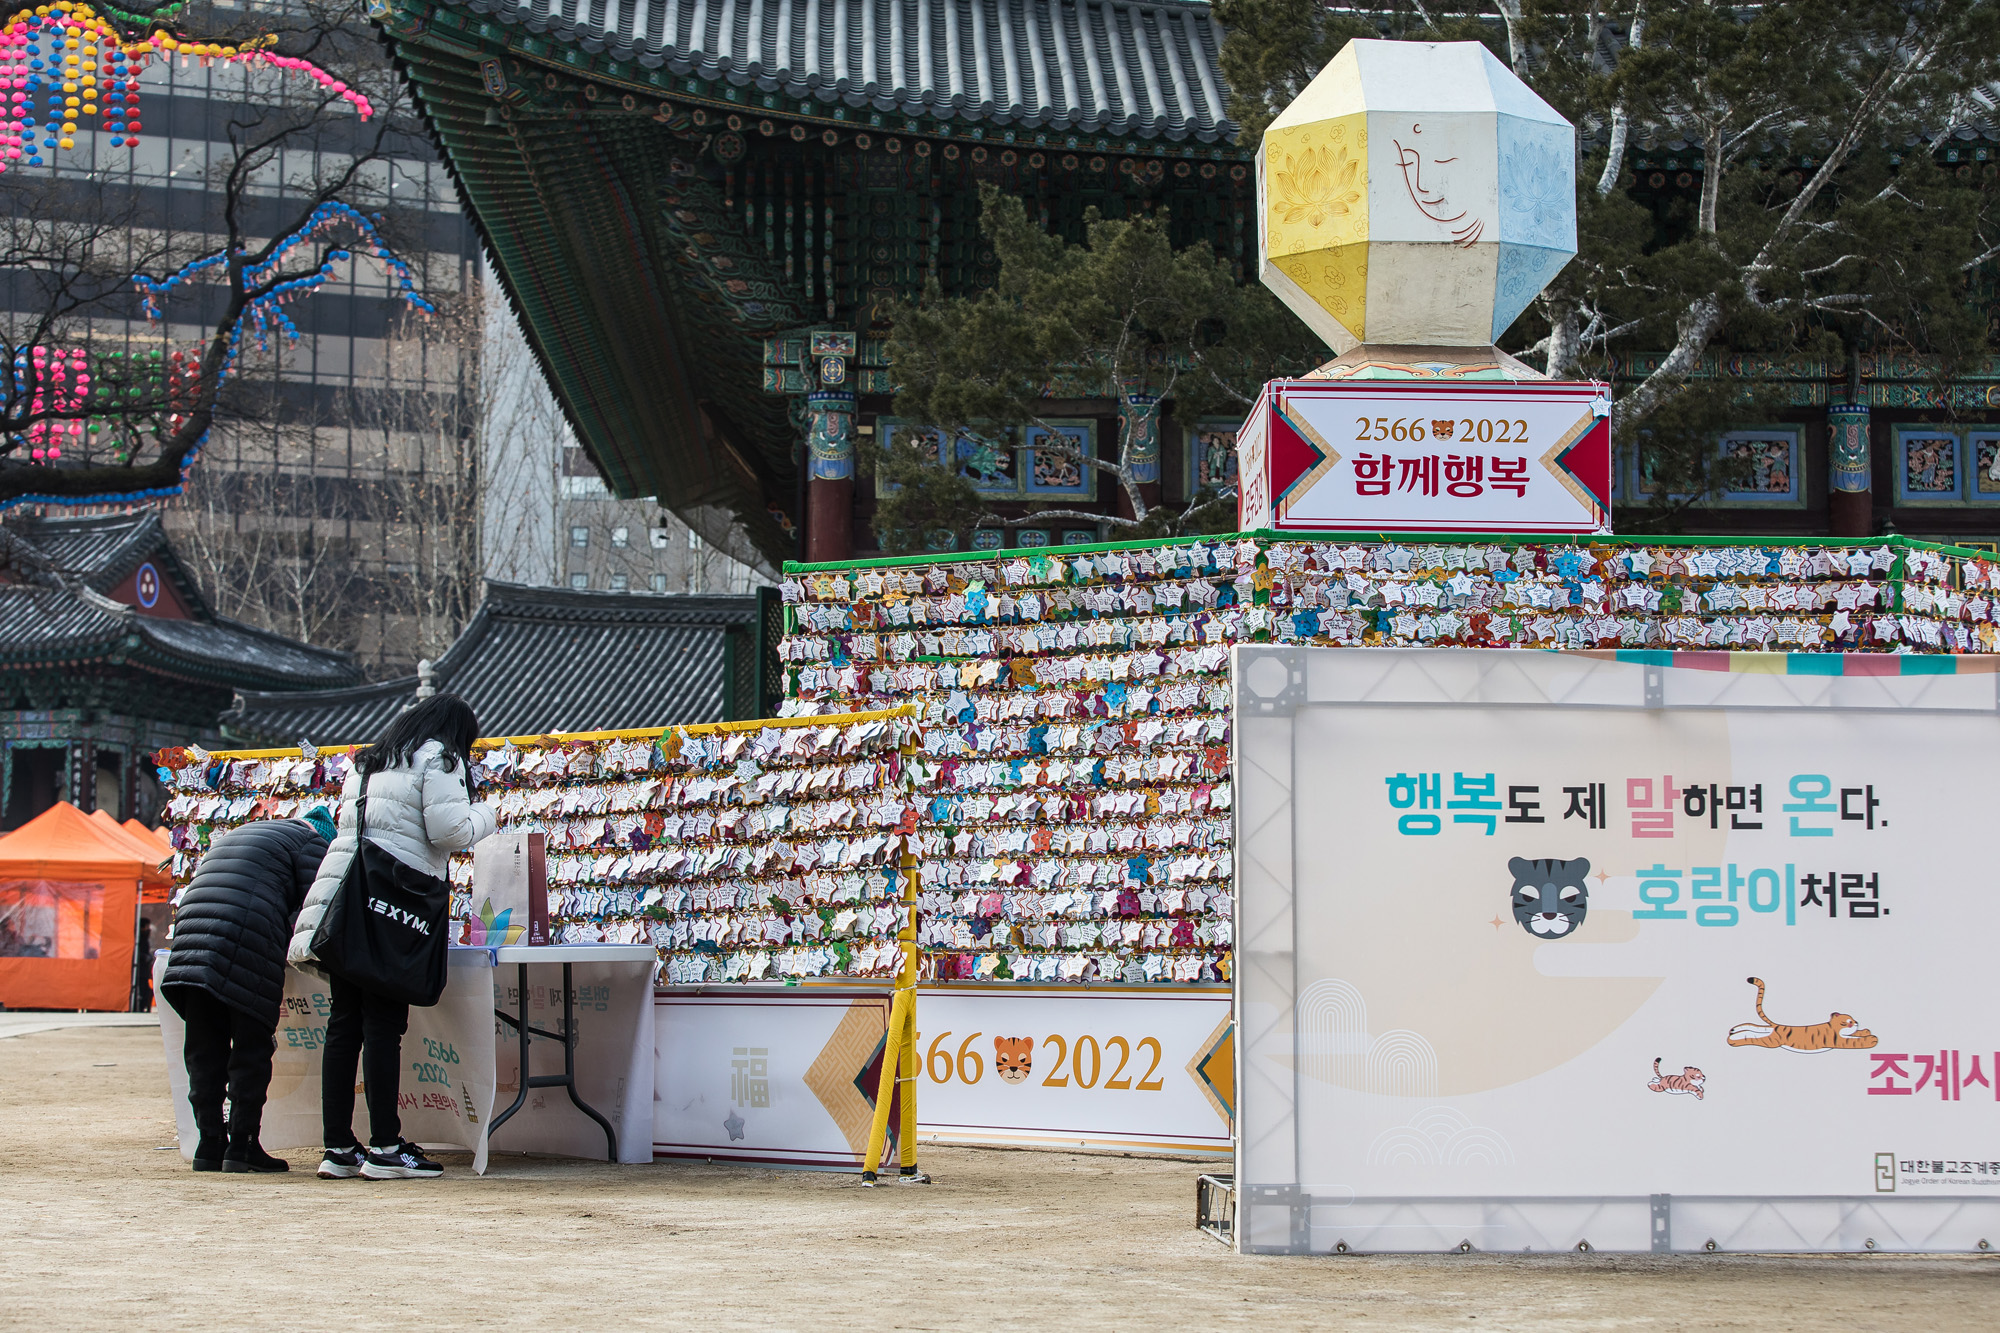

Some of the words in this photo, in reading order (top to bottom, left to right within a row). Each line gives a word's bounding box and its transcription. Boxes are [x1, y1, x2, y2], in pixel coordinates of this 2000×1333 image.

[1355, 417, 1426, 442] 2566
[1459, 418, 1530, 443] 2022
[1351, 452, 1530, 498] 함께행복
[1385, 772, 1546, 836] 행복도
[1562, 782, 1607, 830] 제
[1626, 775, 1764, 838] 말하면
[1781, 774, 1889, 837] 온다.
[1631, 863, 1890, 927] 호랑이처럼.
[311, 992, 334, 1017] 온
[423, 1037, 460, 1065] 2566
[1041, 1034, 1164, 1091] 2022
[412, 1062, 452, 1089] 2022
[731, 1047, 770, 1109] 福
[1867, 1050, 2000, 1102] 조계사
[1900, 1160, 2000, 1175] 대한불교조계종
